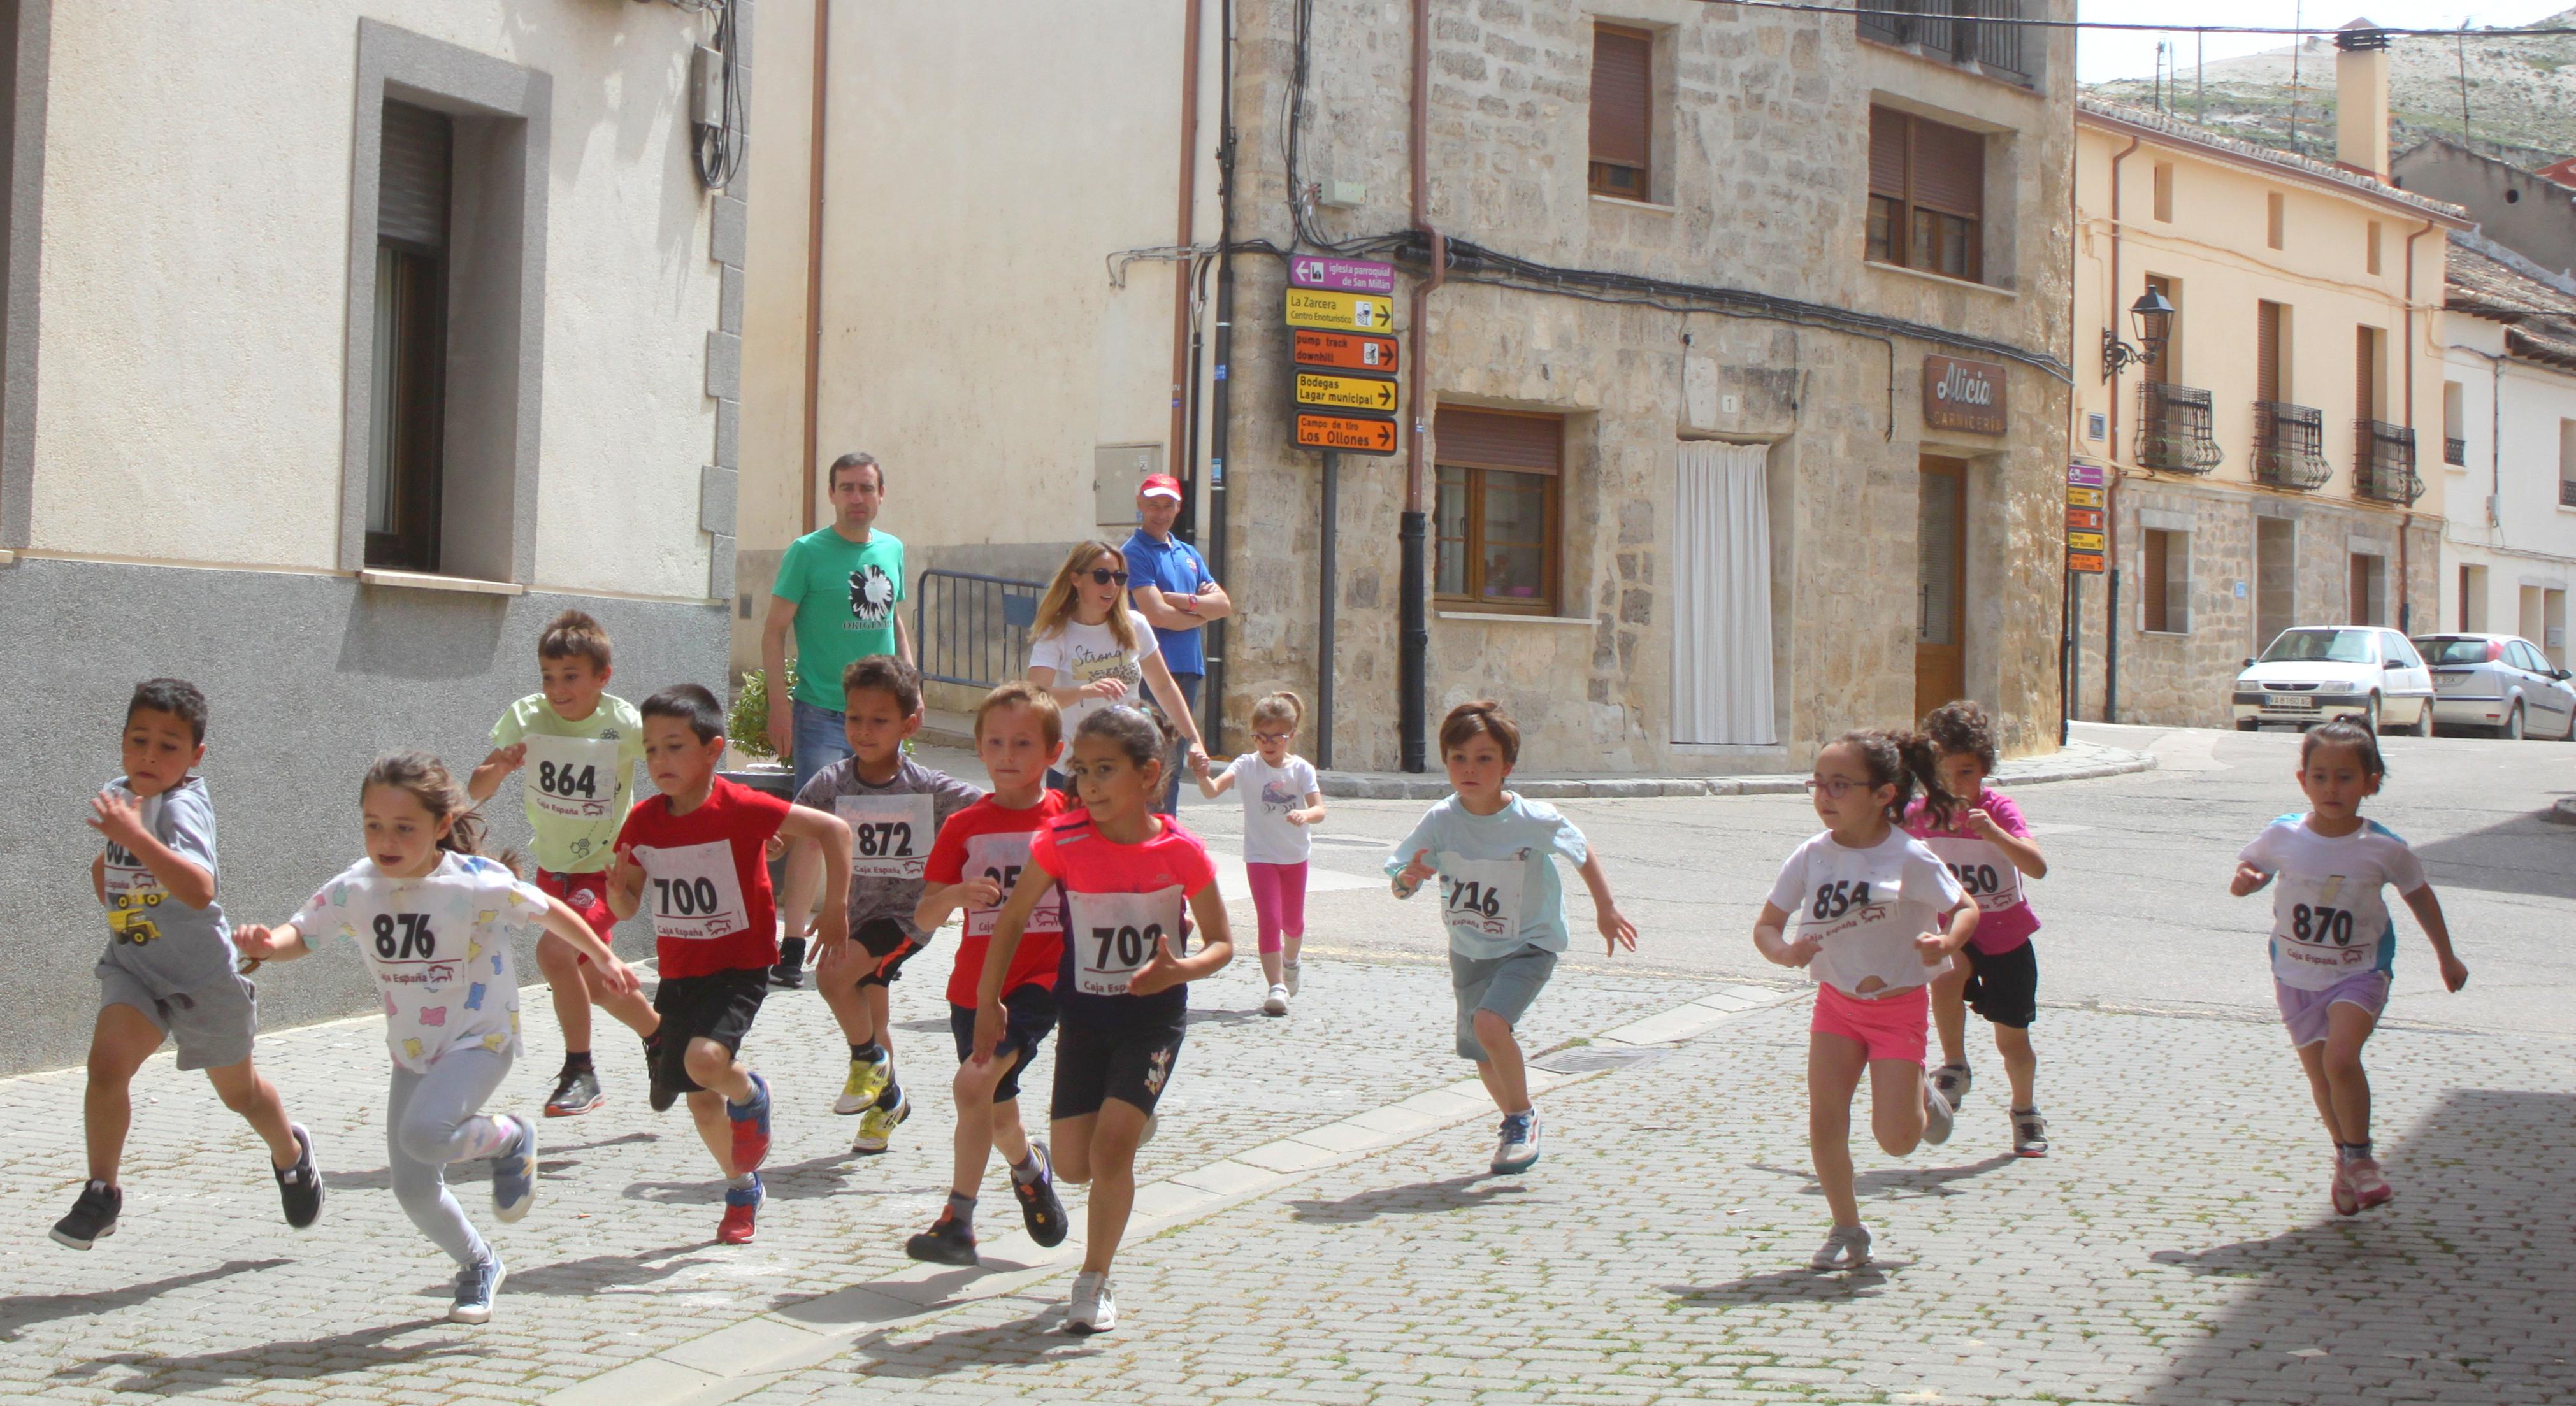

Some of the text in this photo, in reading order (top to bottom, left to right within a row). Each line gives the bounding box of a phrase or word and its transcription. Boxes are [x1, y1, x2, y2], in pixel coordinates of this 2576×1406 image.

[1329, 262, 1390, 278] iglesia parroquial
[1342, 276, 1351, 286] de
[1353, 278, 1367, 287] San
[1291, 296, 1336, 310] La Zarcera
[1290, 310, 1313, 320] Centro
[1297, 336, 1348, 348] pump track
[1297, 350, 1334, 362] downhill
[1300, 375, 1339, 390] Bodegas
[1937, 362, 1993, 406] Alicia
[1300, 389, 1373, 405] Lagar municipal
[1301, 417, 1359, 431] Campo de tiro
[1300, 429, 1369, 446] Los Ollones
[1075, 645, 1123, 667] Strong
[540, 761, 596, 798] 864
[552, 804, 579, 815] España
[858, 822, 912, 856] 872
[854, 866, 901, 875] Caja España
[653, 876, 717, 915] 700
[1813, 880, 1871, 919] 854
[658, 925, 703, 938] Caja España
[2292, 903, 2353, 947] 870
[373, 913, 435, 959] 876
[393, 973, 428, 986] España
[1084, 981, 1104, 993] Caja
